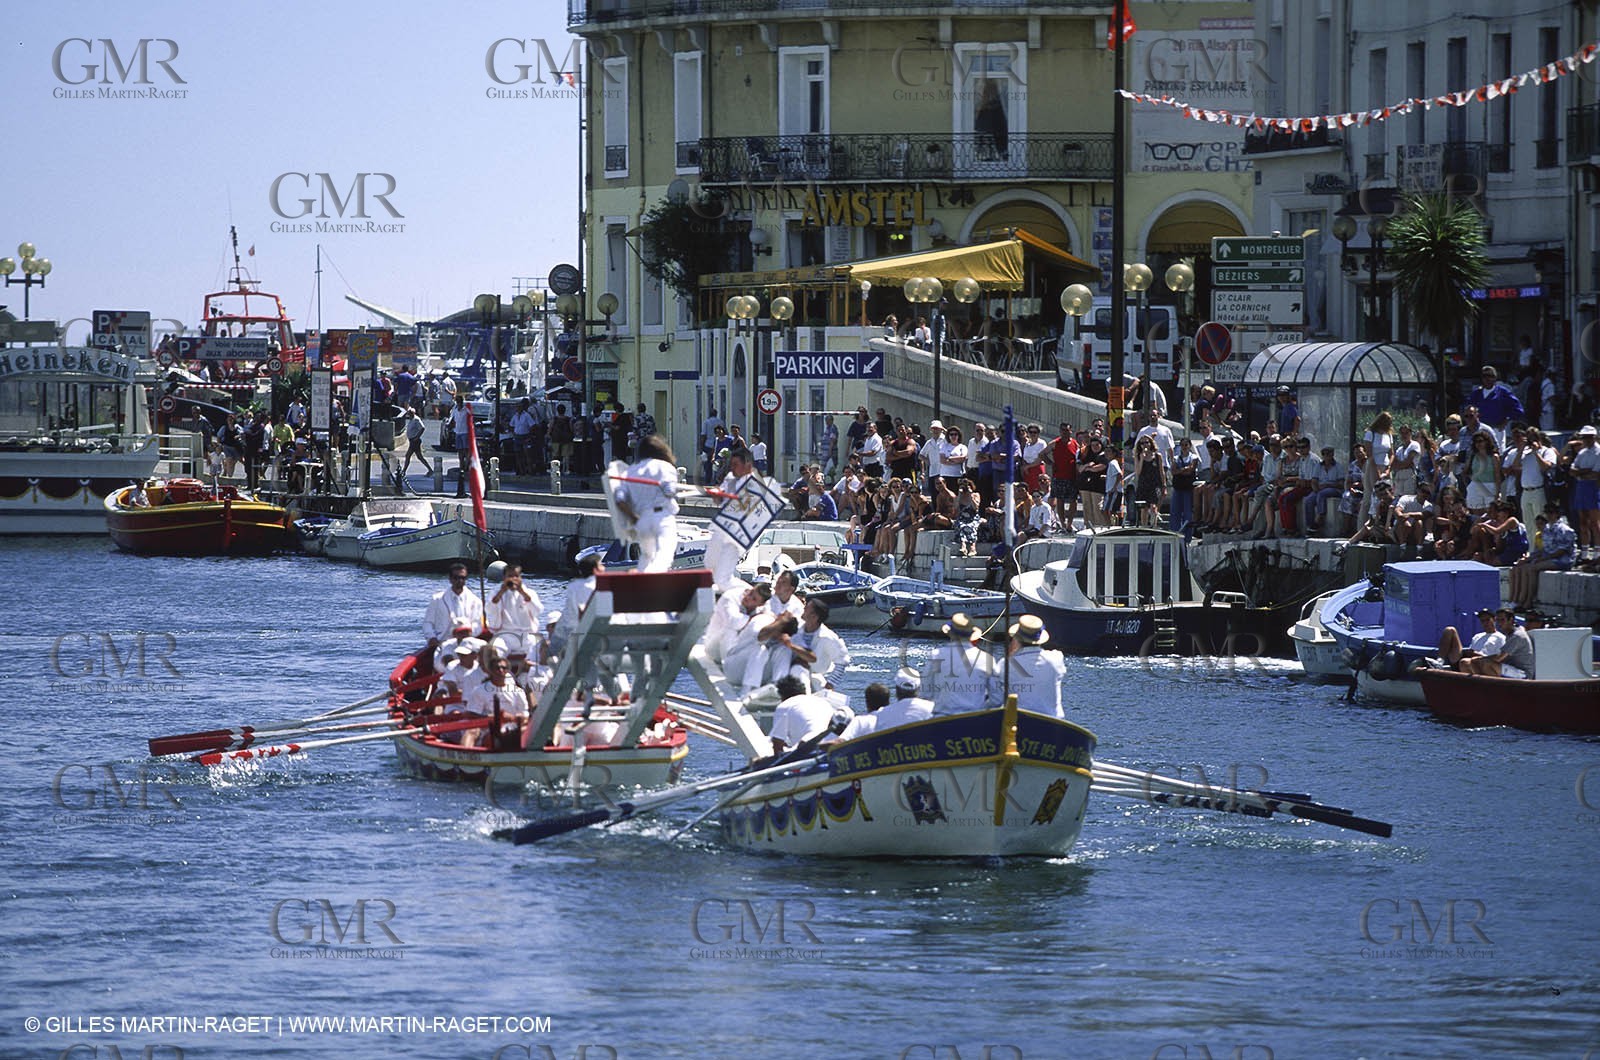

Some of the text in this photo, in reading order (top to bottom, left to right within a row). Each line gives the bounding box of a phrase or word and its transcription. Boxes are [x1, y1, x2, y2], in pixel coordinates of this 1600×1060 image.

[1145, 80, 1247, 91] PARKING ESPLANADE
[800, 190, 933, 227] AMSTEL
[1241, 246, 1301, 254] MONTPELLIER
[1218, 270, 1260, 281] BÉZIERS
[1228, 294, 1252, 302] CLAIR
[1217, 304, 1271, 312] LA CORNICHE
[98, 314, 110, 331] P
[1217, 313, 1238, 321] Hôtel
[1240, 313, 1249, 321] de
[98, 334, 146, 345] CANAL
[1278, 334, 1301, 342] GARE
[180, 340, 191, 352] P
[776, 356, 855, 375] PARKING
[1021, 737, 1040, 755] STE
[835, 756, 850, 774] STE
[855, 752, 872, 768] DES
